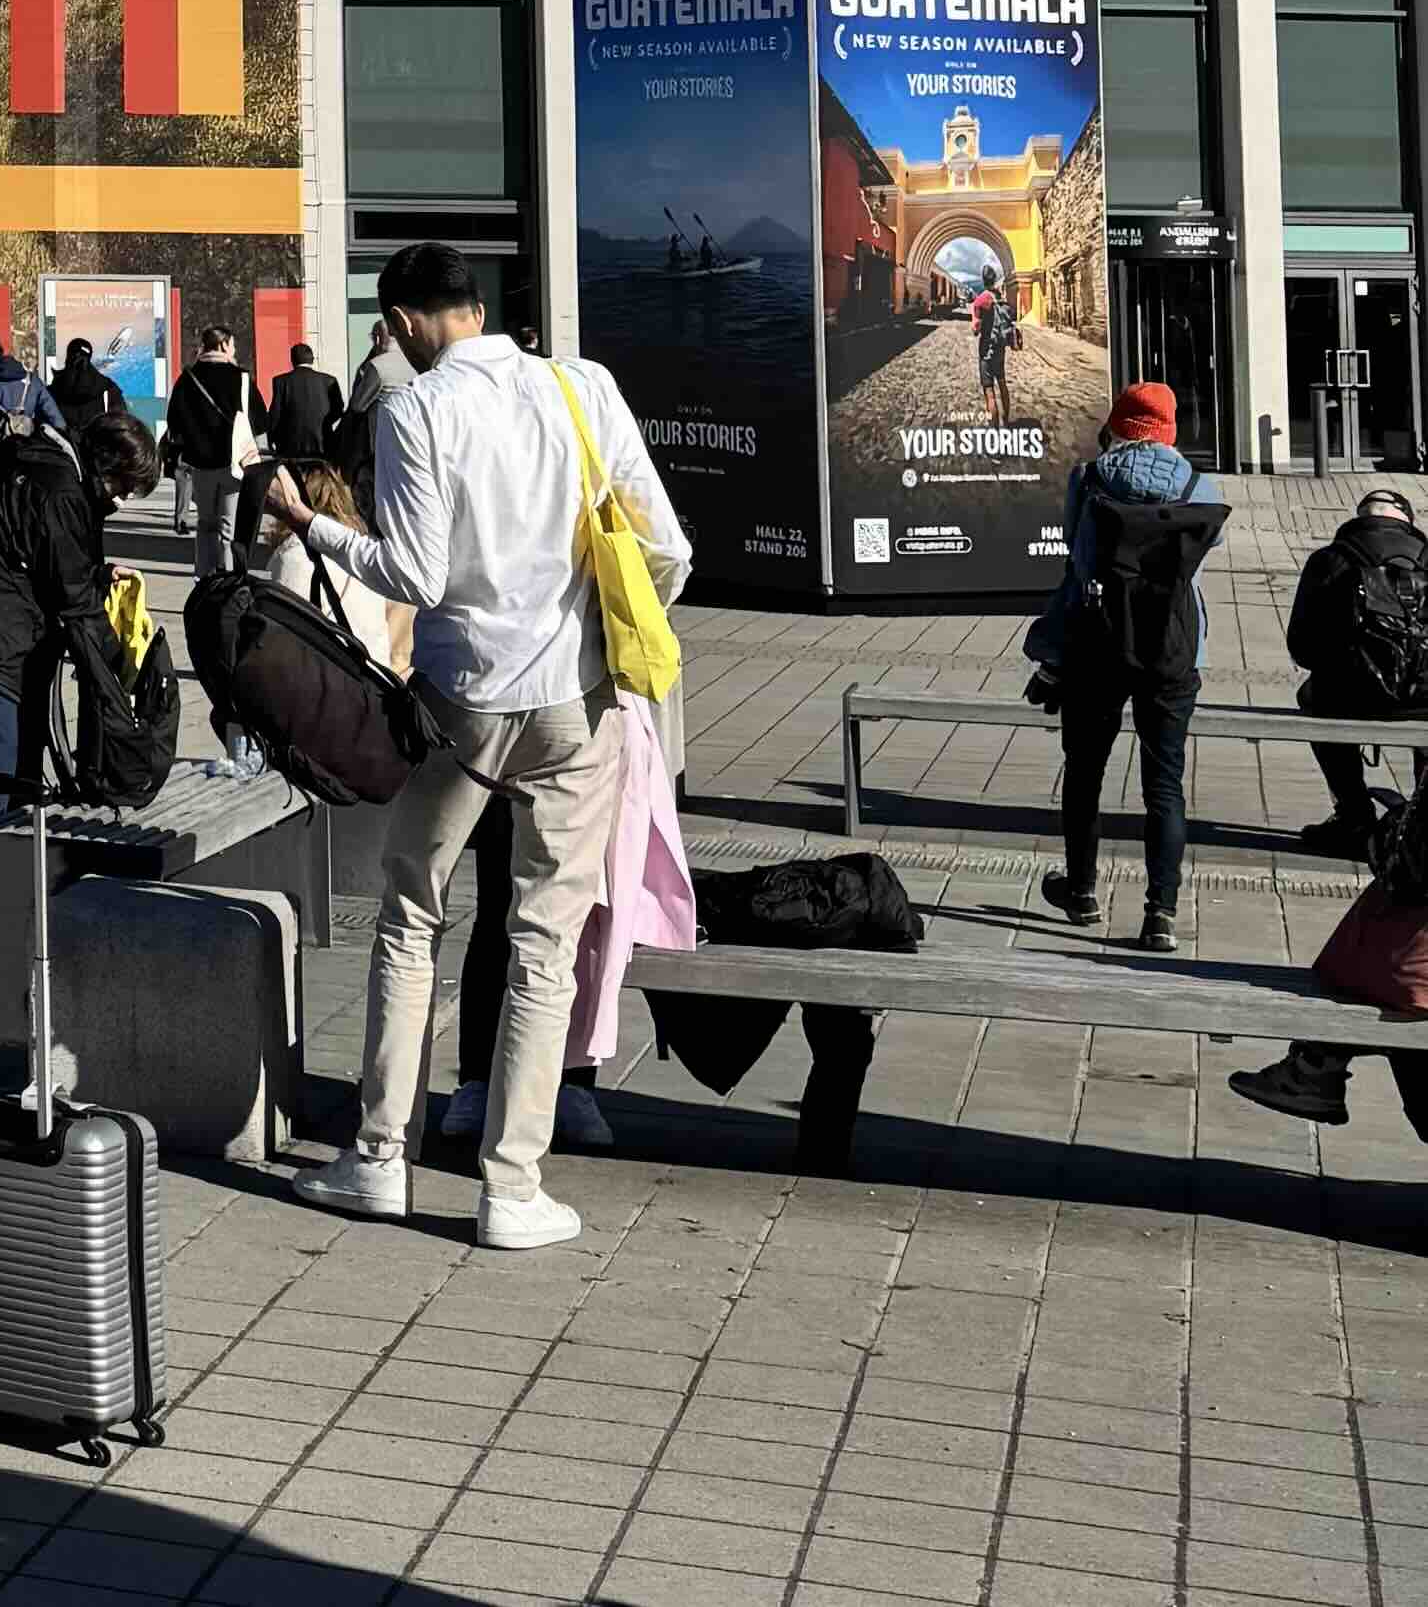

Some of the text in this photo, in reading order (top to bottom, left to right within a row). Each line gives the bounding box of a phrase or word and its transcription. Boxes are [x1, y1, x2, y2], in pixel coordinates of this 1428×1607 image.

[602, 36, 777, 59] NEW SEASON AVAILABLE
[852, 33, 1066, 55] NEW SEASON AVAILABLE
[644, 75, 735, 100] YOUR STORIES
[907, 73, 1017, 99] YOUR STORIES
[685, 421, 756, 457] STORIES
[899, 427, 1044, 460] YOUR STORIES
[755, 524, 786, 540] HALL
[744, 539, 783, 555] STAND
